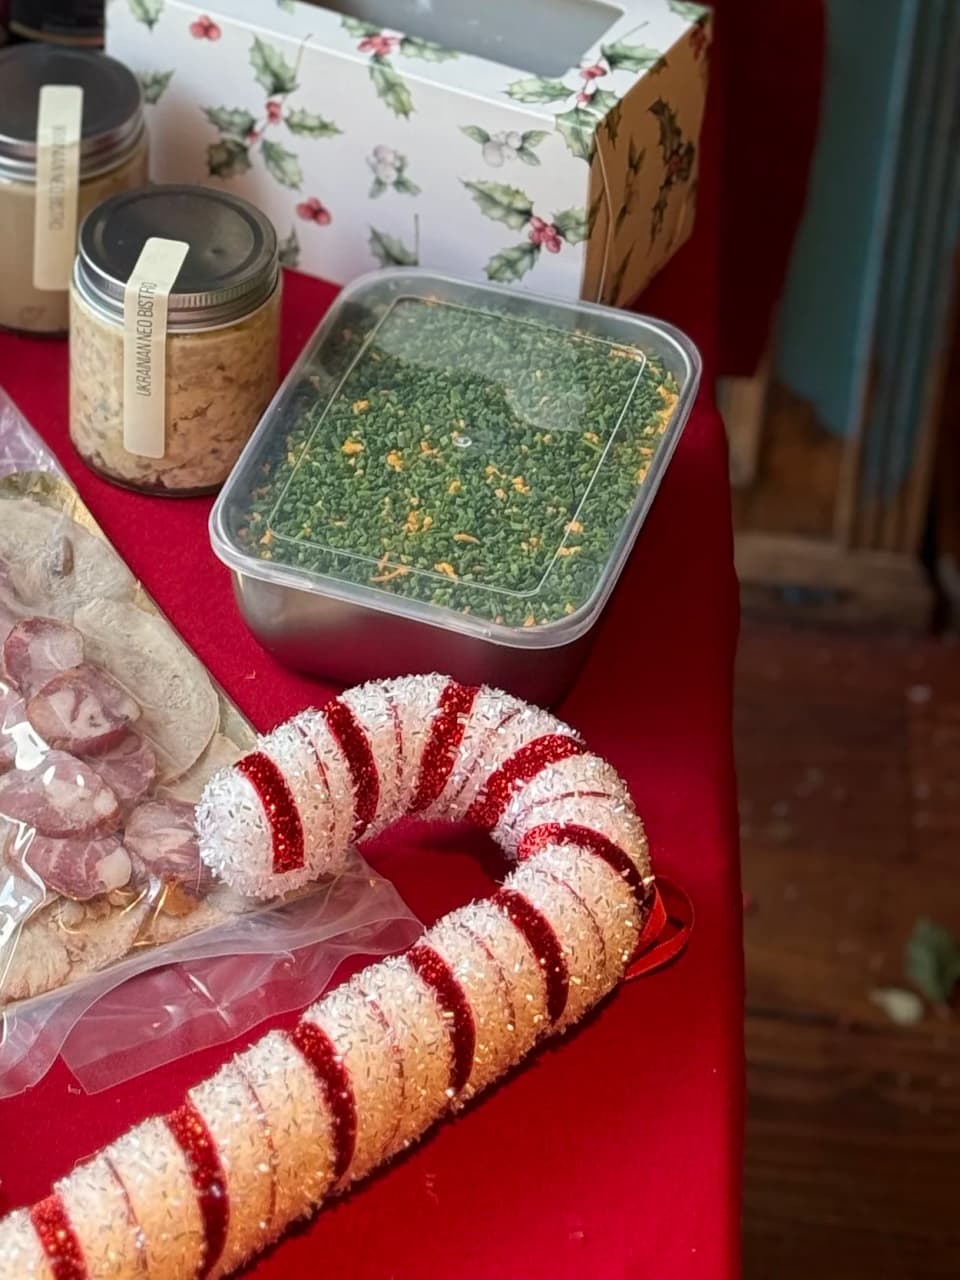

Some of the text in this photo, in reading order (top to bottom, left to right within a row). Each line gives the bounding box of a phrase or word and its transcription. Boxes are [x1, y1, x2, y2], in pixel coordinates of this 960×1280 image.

[136, 281, 158, 398] UKRAINIAN NEO BISTRO
